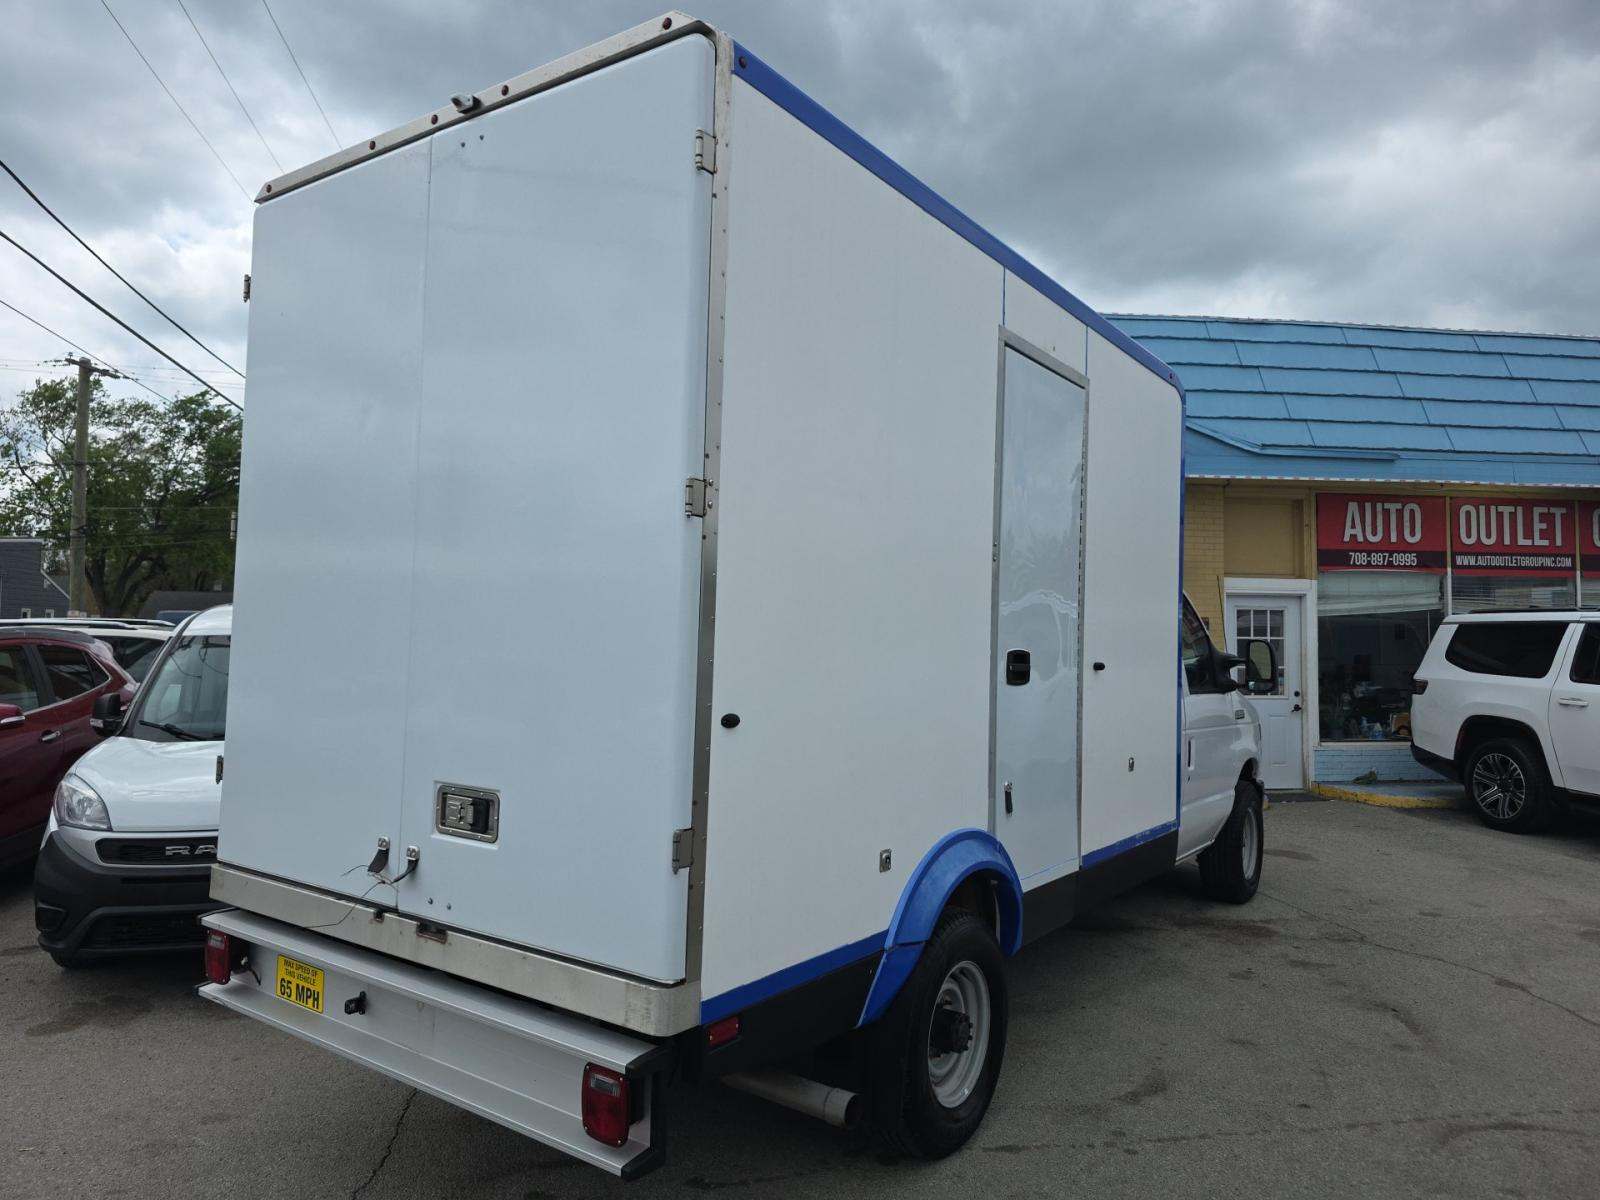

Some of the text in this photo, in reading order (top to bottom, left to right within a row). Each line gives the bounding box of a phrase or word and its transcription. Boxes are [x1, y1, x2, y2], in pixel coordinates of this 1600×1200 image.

[1343, 501, 1422, 544] AUTO
[1459, 504, 1567, 547] OUTLET
[1349, 552, 1418, 566] 708-897-0995
[1455, 554, 1572, 568] WWW.AUTOOUTLETGROUPINC.COM
[280, 977, 320, 1010] 65 MPH
